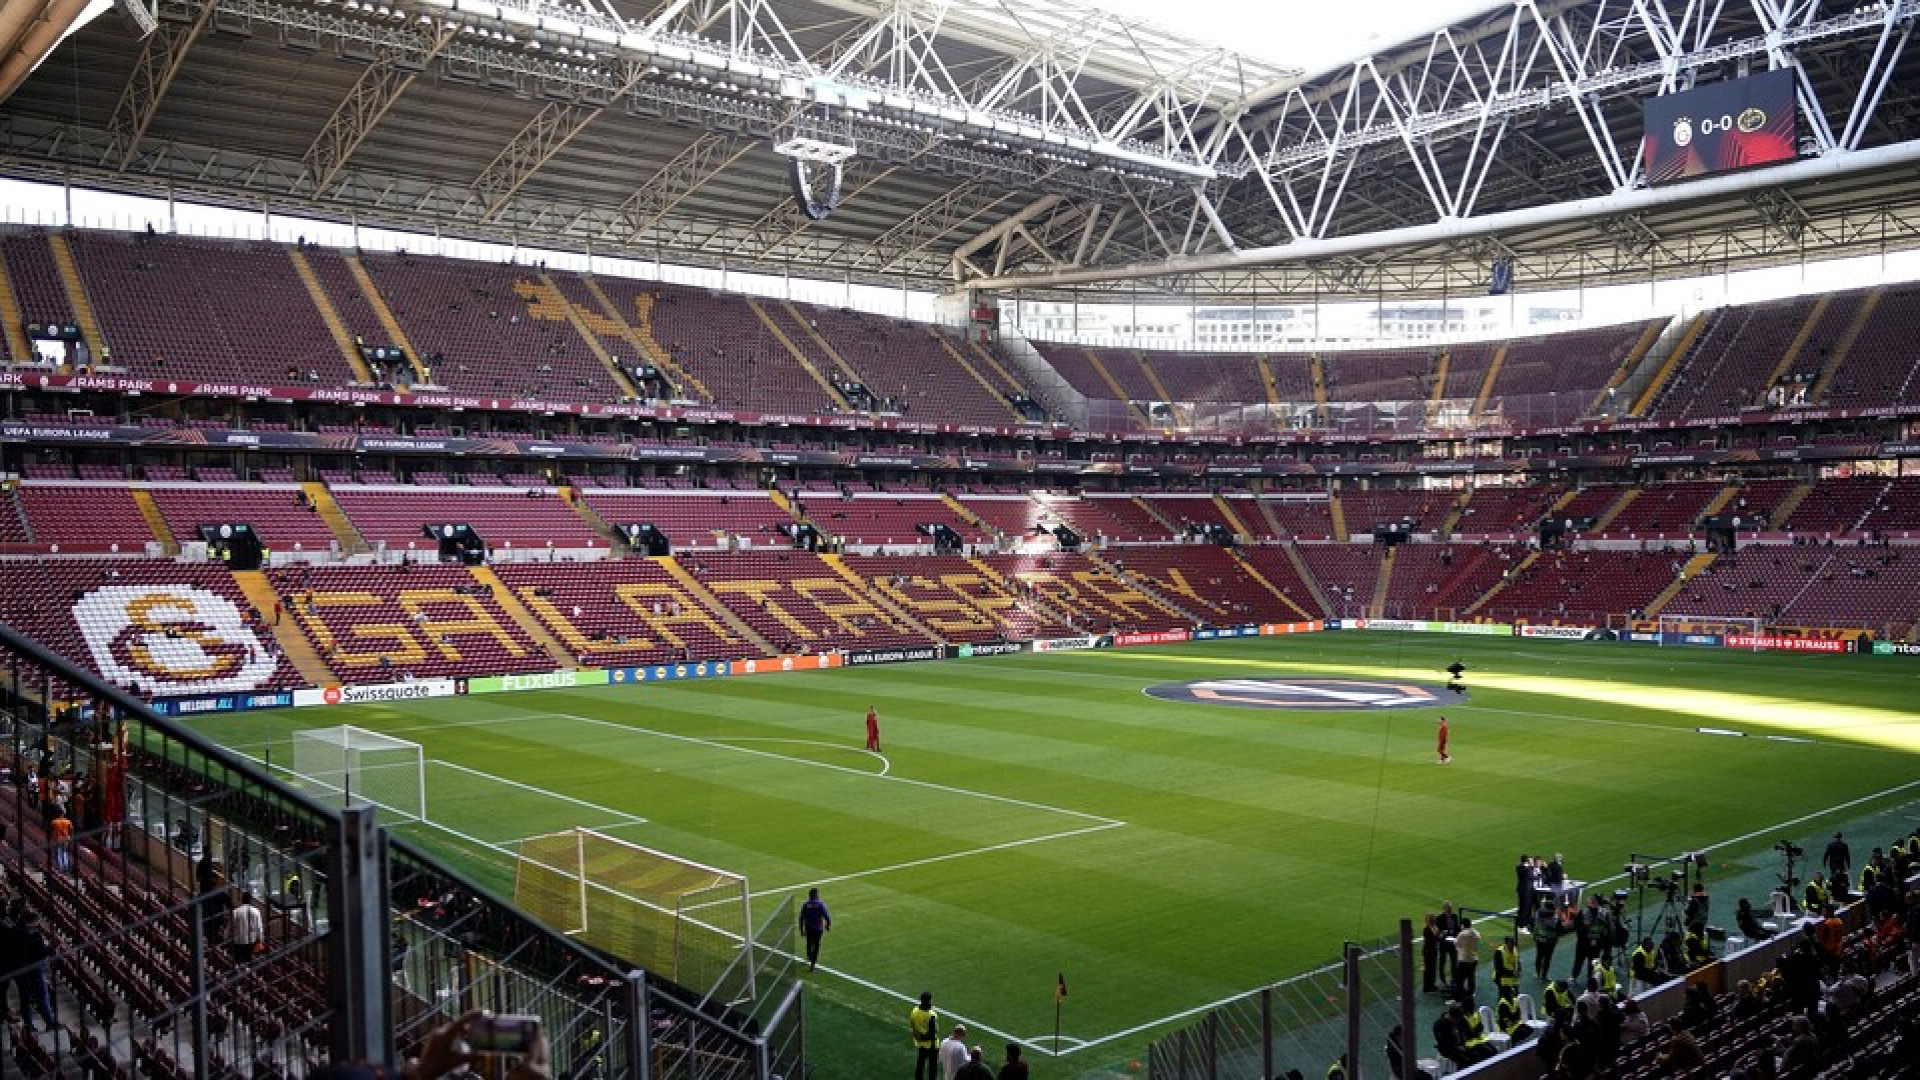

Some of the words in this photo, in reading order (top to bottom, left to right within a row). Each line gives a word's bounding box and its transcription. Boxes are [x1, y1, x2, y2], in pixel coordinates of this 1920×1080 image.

[1701, 114, 1733, 135] 0-0
[78, 377, 115, 389] RAMS
[119, 380, 153, 391] PARK
[204, 383, 238, 395] RAMS
[241, 386, 273, 397] PARK
[318, 390, 348, 400] RAMS
[352, 392, 381, 403] PARK
[422, 396, 450, 405] RAMS
[454, 398, 480, 407] PARK
[518, 401, 545, 410] RAMS
[547, 403, 571, 412] PARK
[1867, 407, 1894, 416] RAMS
[1776, 412, 1802, 421] RAMS
[1805, 411, 1829, 419] PARK
[4, 427, 30, 436] UEFA
[34, 428, 70, 438] EUROPA
[74, 429, 110, 439] LEAGUE
[386, 441, 414, 449] EUROPA
[416, 441, 444, 449] LEAGUE
[1794, 640, 1840, 651] STRAUSS
[853, 653, 874, 663] UEFA
[875, 651, 904, 662] EUROPA
[907, 649, 934, 660] LEAGUE
[503, 671, 576, 690] FLIXBUS
[344, 684, 430, 702] Swissquote
